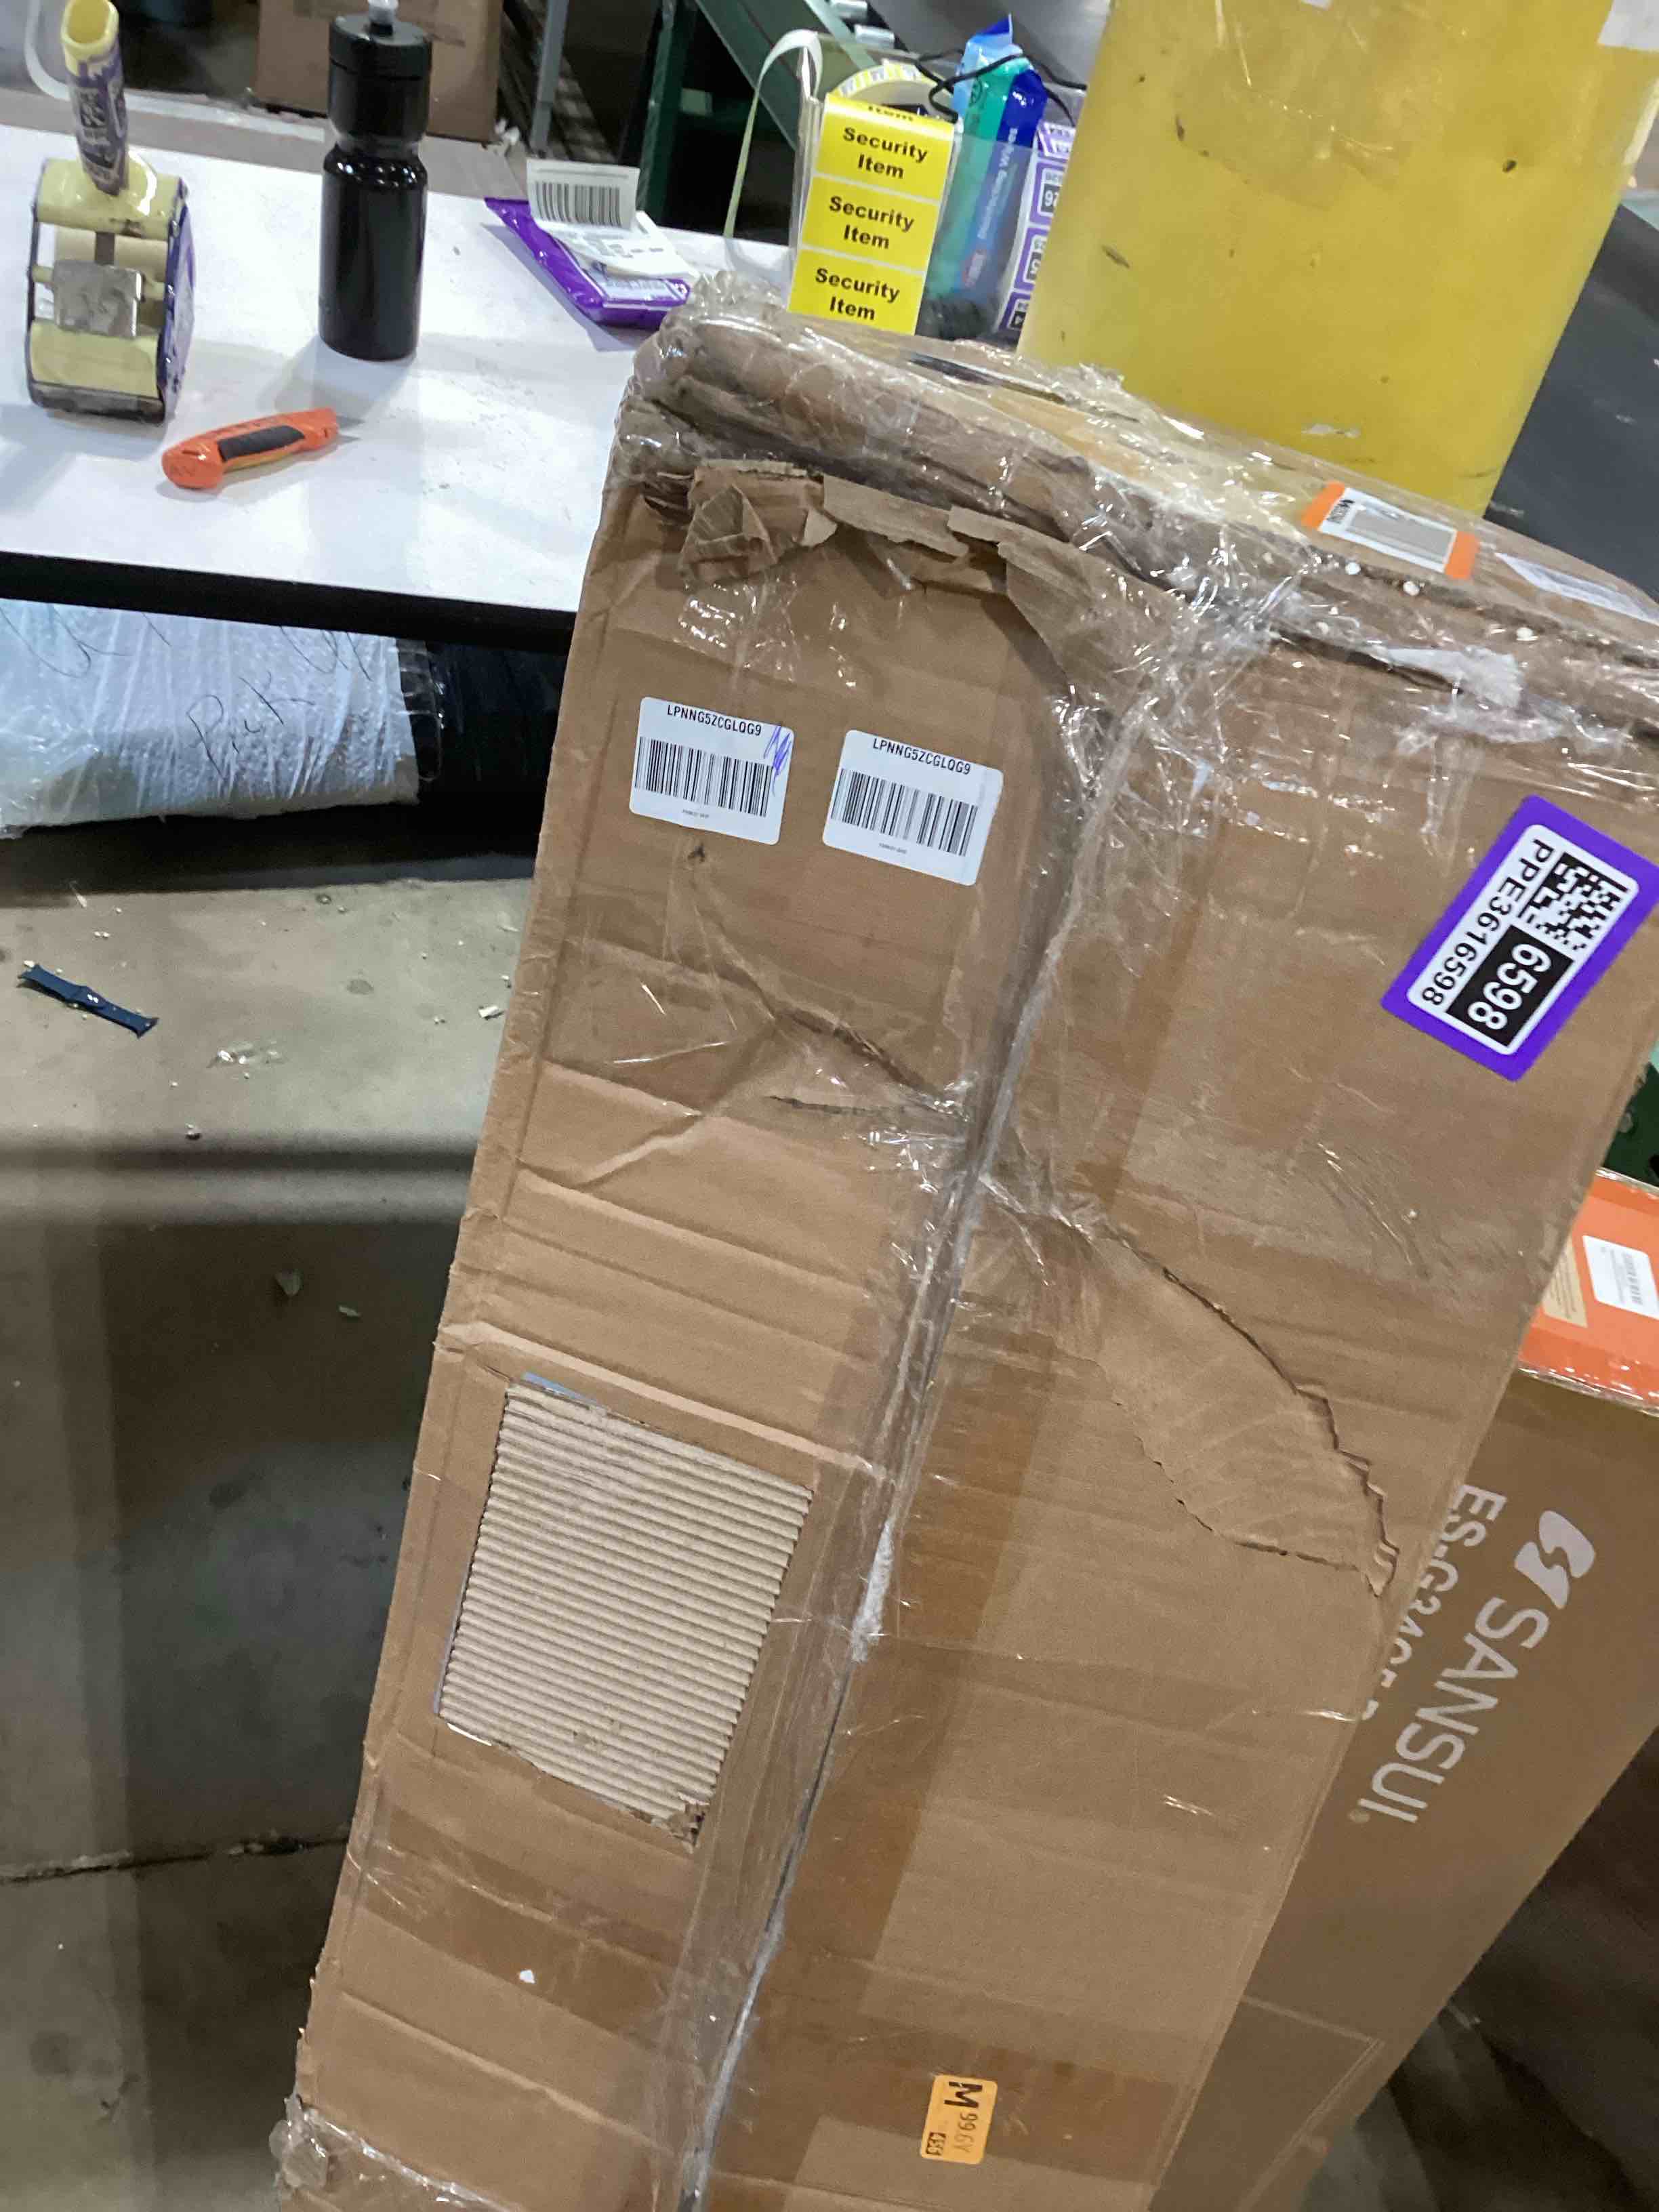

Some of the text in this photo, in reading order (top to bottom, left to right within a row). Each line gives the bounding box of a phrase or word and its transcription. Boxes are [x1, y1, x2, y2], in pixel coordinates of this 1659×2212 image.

[842, 126, 928, 163] Security
[857, 153, 905, 180] Item
[829, 195, 915, 232] Security
[843, 224, 890, 250] Item
[815, 268, 901, 304] Security
[829, 296, 876, 321] Item
[1422, 838, 1555, 1006] PPE3616598
[1467, 943, 1552, 1031] 6598
[1357, 1597, 1550, 1823] SANSUI
[943, 2081, 983, 2109] M
